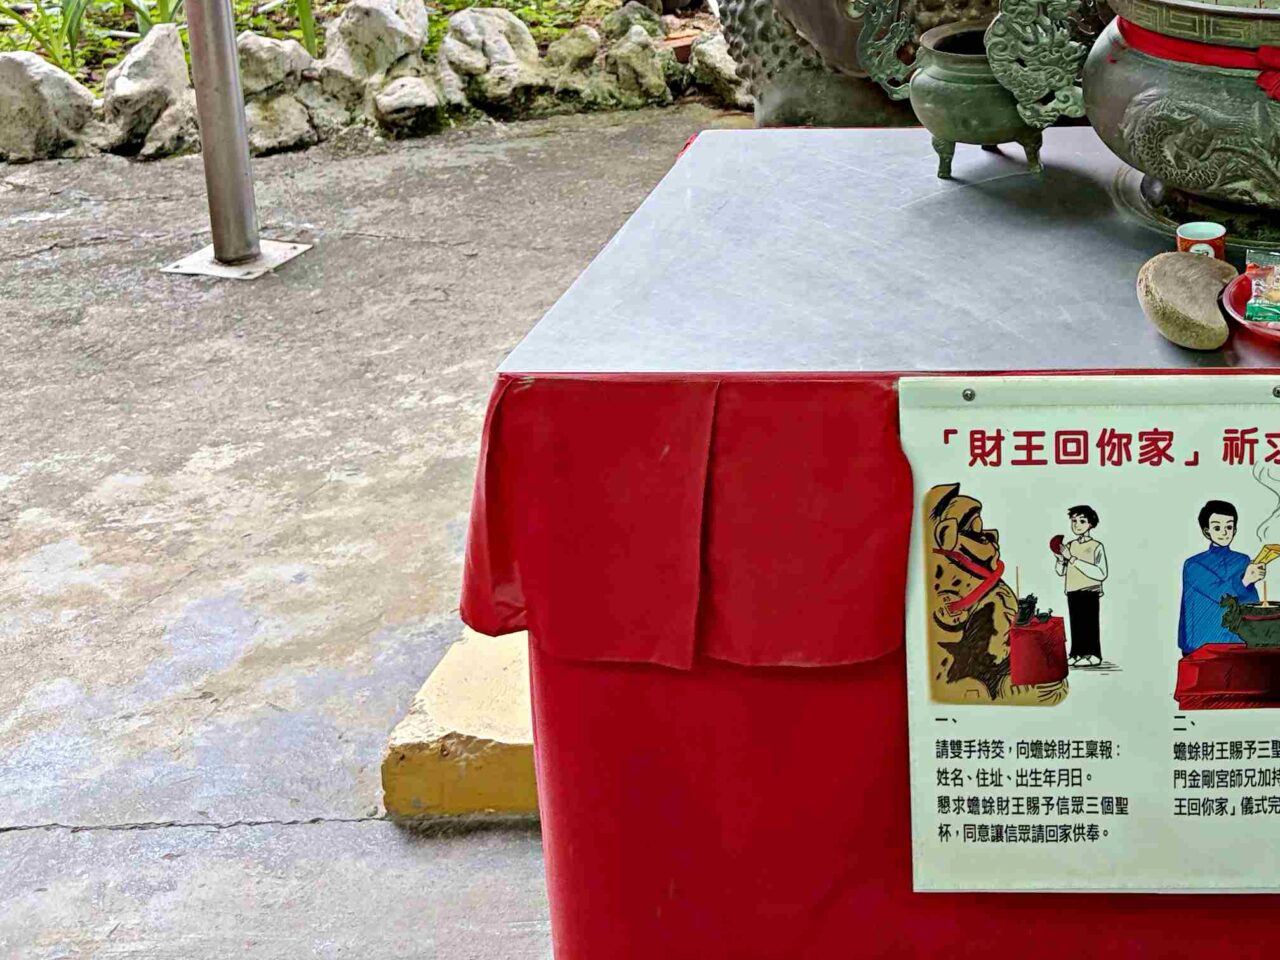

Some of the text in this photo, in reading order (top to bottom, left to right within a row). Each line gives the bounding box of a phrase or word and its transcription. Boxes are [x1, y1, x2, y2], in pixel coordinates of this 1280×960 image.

[1173, 716, 1195, 731] 二、
[937, 768, 1091, 787] 姓名、住址、出生年月日。
[938, 796, 1128, 815] 懇求蟾蜍財王賜予信眾三個聖
[938, 823, 1108, 843] 杯，同意讓信眾請回家供奉。
